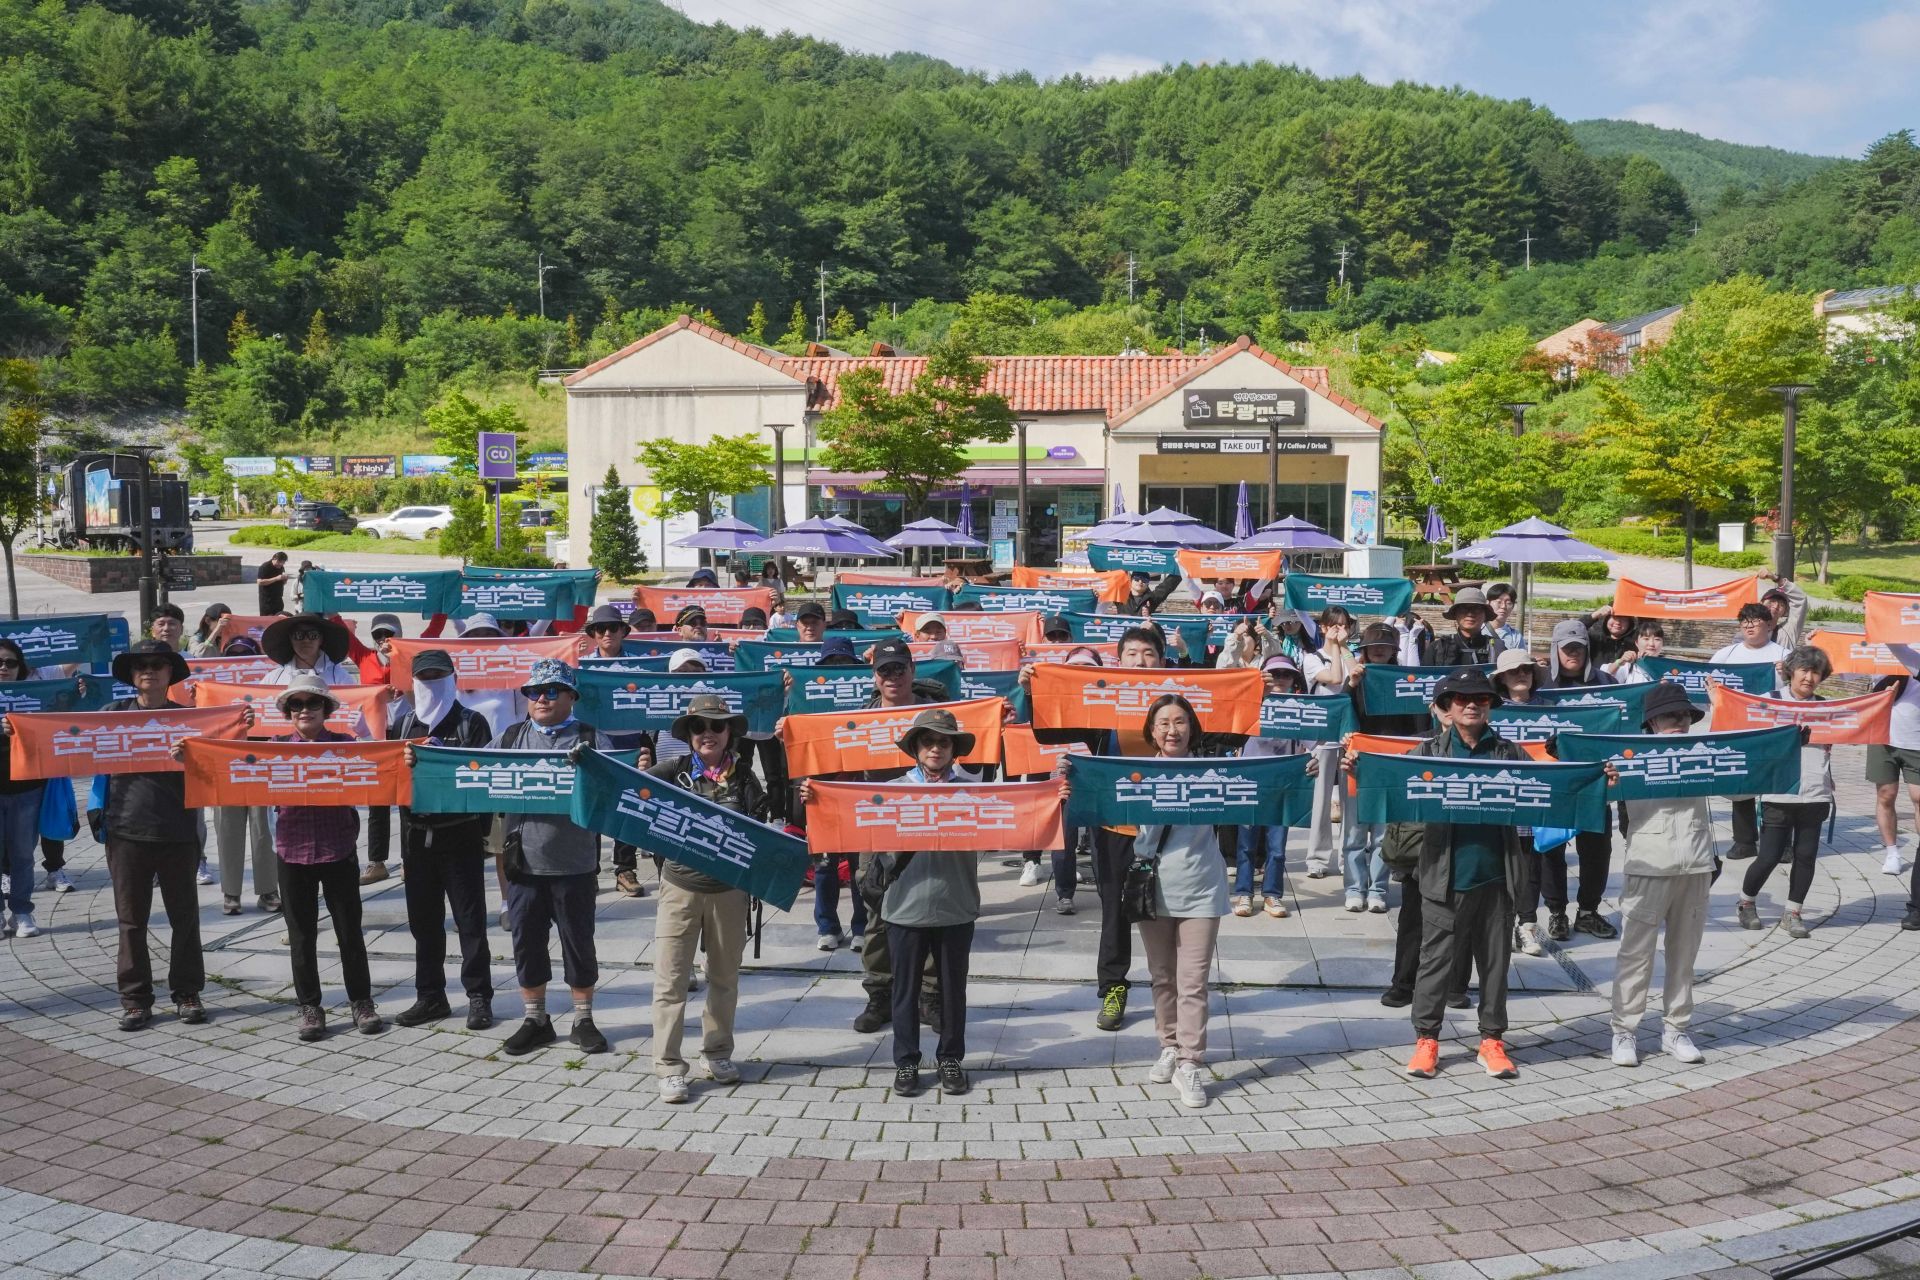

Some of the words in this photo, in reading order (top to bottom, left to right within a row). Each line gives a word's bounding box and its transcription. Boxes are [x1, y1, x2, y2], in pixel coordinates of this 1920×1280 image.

[490, 450, 508, 459] CU
[1223, 442, 1244, 450] TAKE
[1245, 442, 1261, 450] OUT
[334, 577, 427, 601] 운탄고도
[1307, 583, 1384, 605] 운탄고도
[229, 751, 379, 789] 운탄고도
[1604, 745, 1748, 781] 운탄고도
[1115, 769, 1259, 807] 운탄고도
[1406, 769, 1551, 807] 운탄고도
[616, 788, 757, 869] 운탄고도
[855, 791, 1016, 832] 운탄고도
